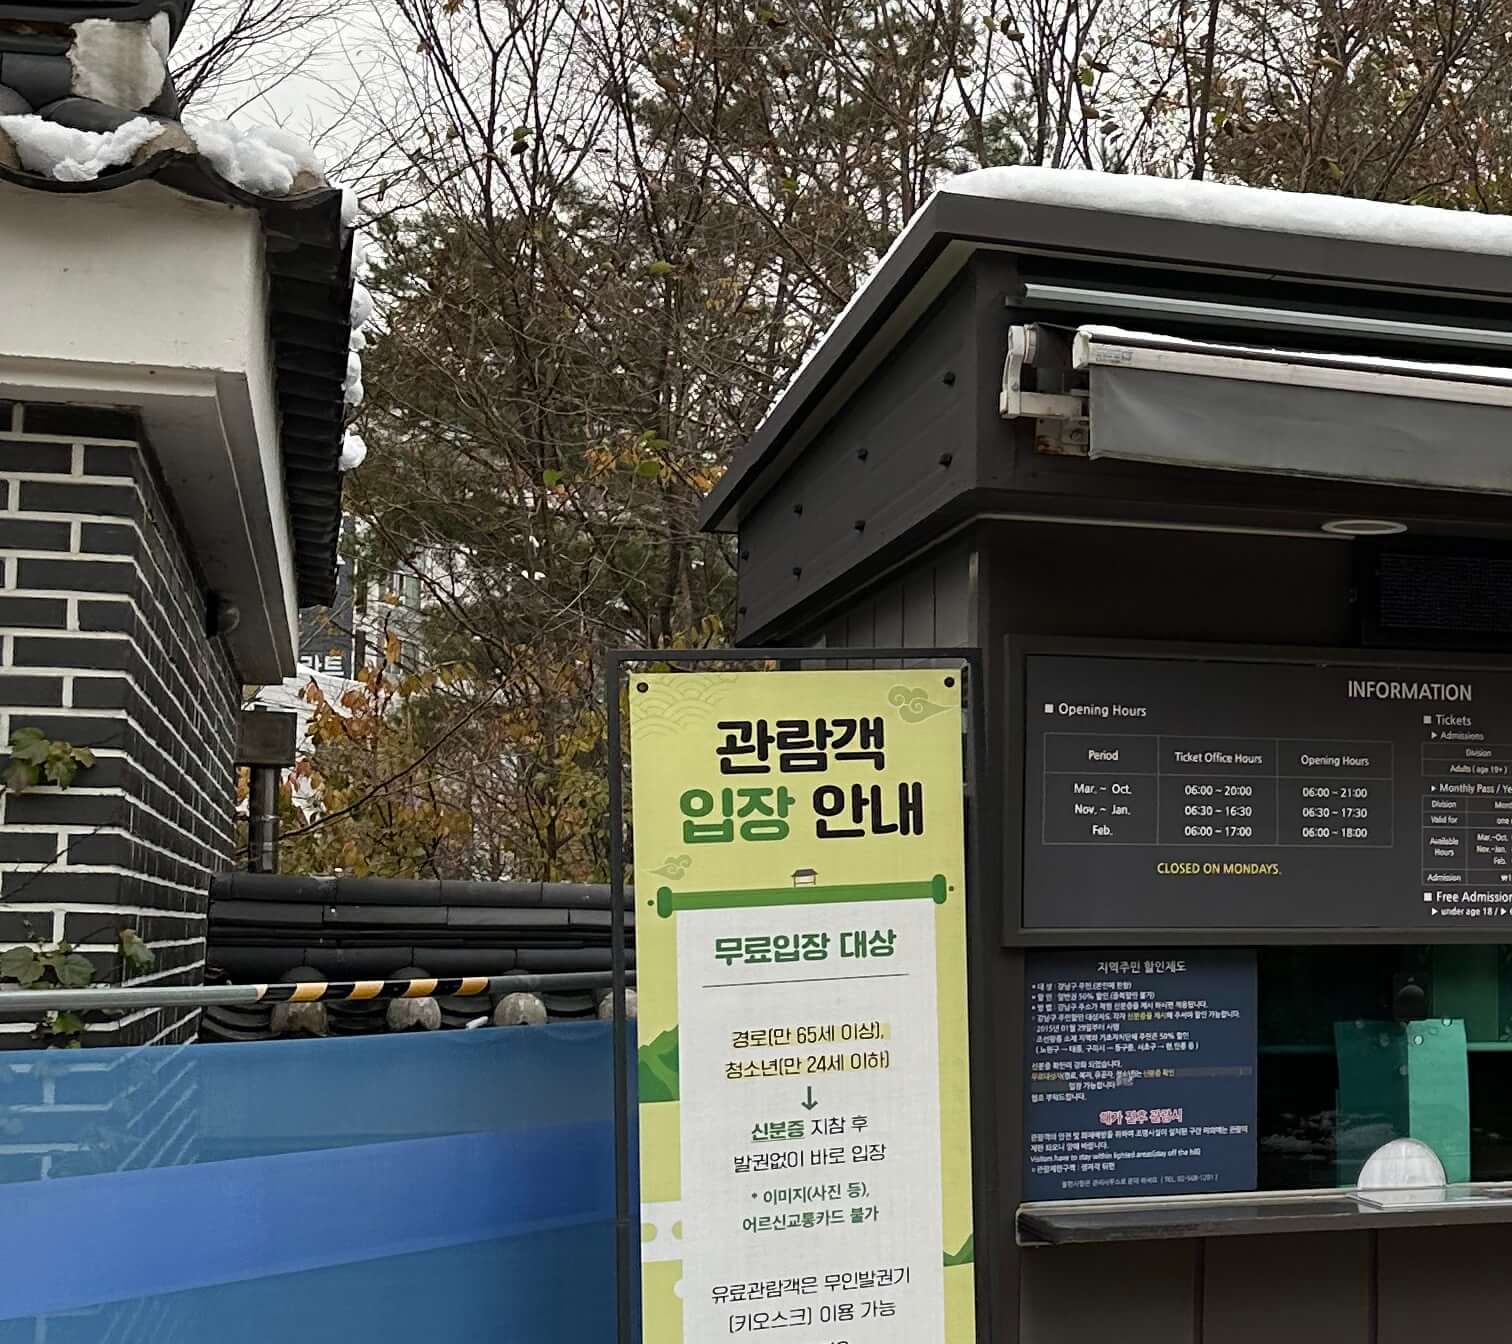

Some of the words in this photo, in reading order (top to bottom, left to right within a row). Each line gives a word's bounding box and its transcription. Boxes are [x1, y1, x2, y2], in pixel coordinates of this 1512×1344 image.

[1347, 679, 1472, 702] INFORMATION
[1059, 703, 1109, 717] Opening
[1113, 705, 1147, 717] Hours
[1436, 715, 1472, 726] Tickets
[1440, 732, 1484, 740] Admissions
[716, 716, 886, 775] 관람객
[1089, 750, 1119, 761] Period
[1175, 752, 1202, 763] Ticket
[1205, 753, 1232, 764] Office
[1235, 754, 1262, 764] Hours
[1301, 755, 1340, 767] Opening
[1343, 756, 1369, 766] Hours
[1185, 785, 1213, 796] 06:00
[1225, 786, 1252, 796] 20:00
[1303, 787, 1330, 798] 06:00
[1341, 788, 1368, 798] 21:00
[1439, 784, 1475, 794] Monthly
[1477, 785, 1494, 794] Pass
[679, 785, 796, 844] 입장
[812, 781, 924, 840] 안내
[1075, 804, 1097, 815] Nov.
[1112, 804, 1131, 815] Jan.
[1185, 806, 1213, 817] 06:30
[1225, 806, 1252, 817] 16:30
[1303, 808, 1330, 818] 06:30
[1341, 808, 1368, 818] 17:30
[1092, 825, 1113, 836] Feb.
[1185, 826, 1213, 837] 06:00
[1225, 826, 1252, 837] 17:00
[1303, 828, 1330, 838] 06:00
[1158, 863, 1200, 874] CLOSED
[1203, 864, 1221, 874] ON
[1223, 864, 1281, 875] MONDAYS.
[1436, 892, 1459, 902] Free
[1466, 909, 1480, 917] age
[1482, 908, 1492, 916] 18
[715, 932, 830, 966] 무료입장
[839, 929, 896, 958] 대상
[1097, 961, 1140, 974] 지역주민
[1145, 960, 1187, 973] 할인제도
[797, 1025, 834, 1044] 65세
[807, 1055, 844, 1074] 24세
[752, 1120, 804, 1141] 신분증
[811, 1117, 845, 1136] 지참
[850, 1116, 868, 1132] 후
[734, 1151, 804, 1173] 발권없이
[810, 1148, 845, 1166] 바로
[852, 1144, 886, 1163] 입장
[764, 1184, 841, 1206] 이미지(사진
[847, 1182, 869, 1199] 등),
[742, 1210, 845, 1233] 어르신교통카드
[850, 1205, 879, 1223] 불가
[711, 1276, 818, 1305] 유료관람객은
[824, 1267, 911, 1292] 무인발권기
[820, 1303, 854, 1323] 이용
[860, 1300, 896, 1318] 가능
